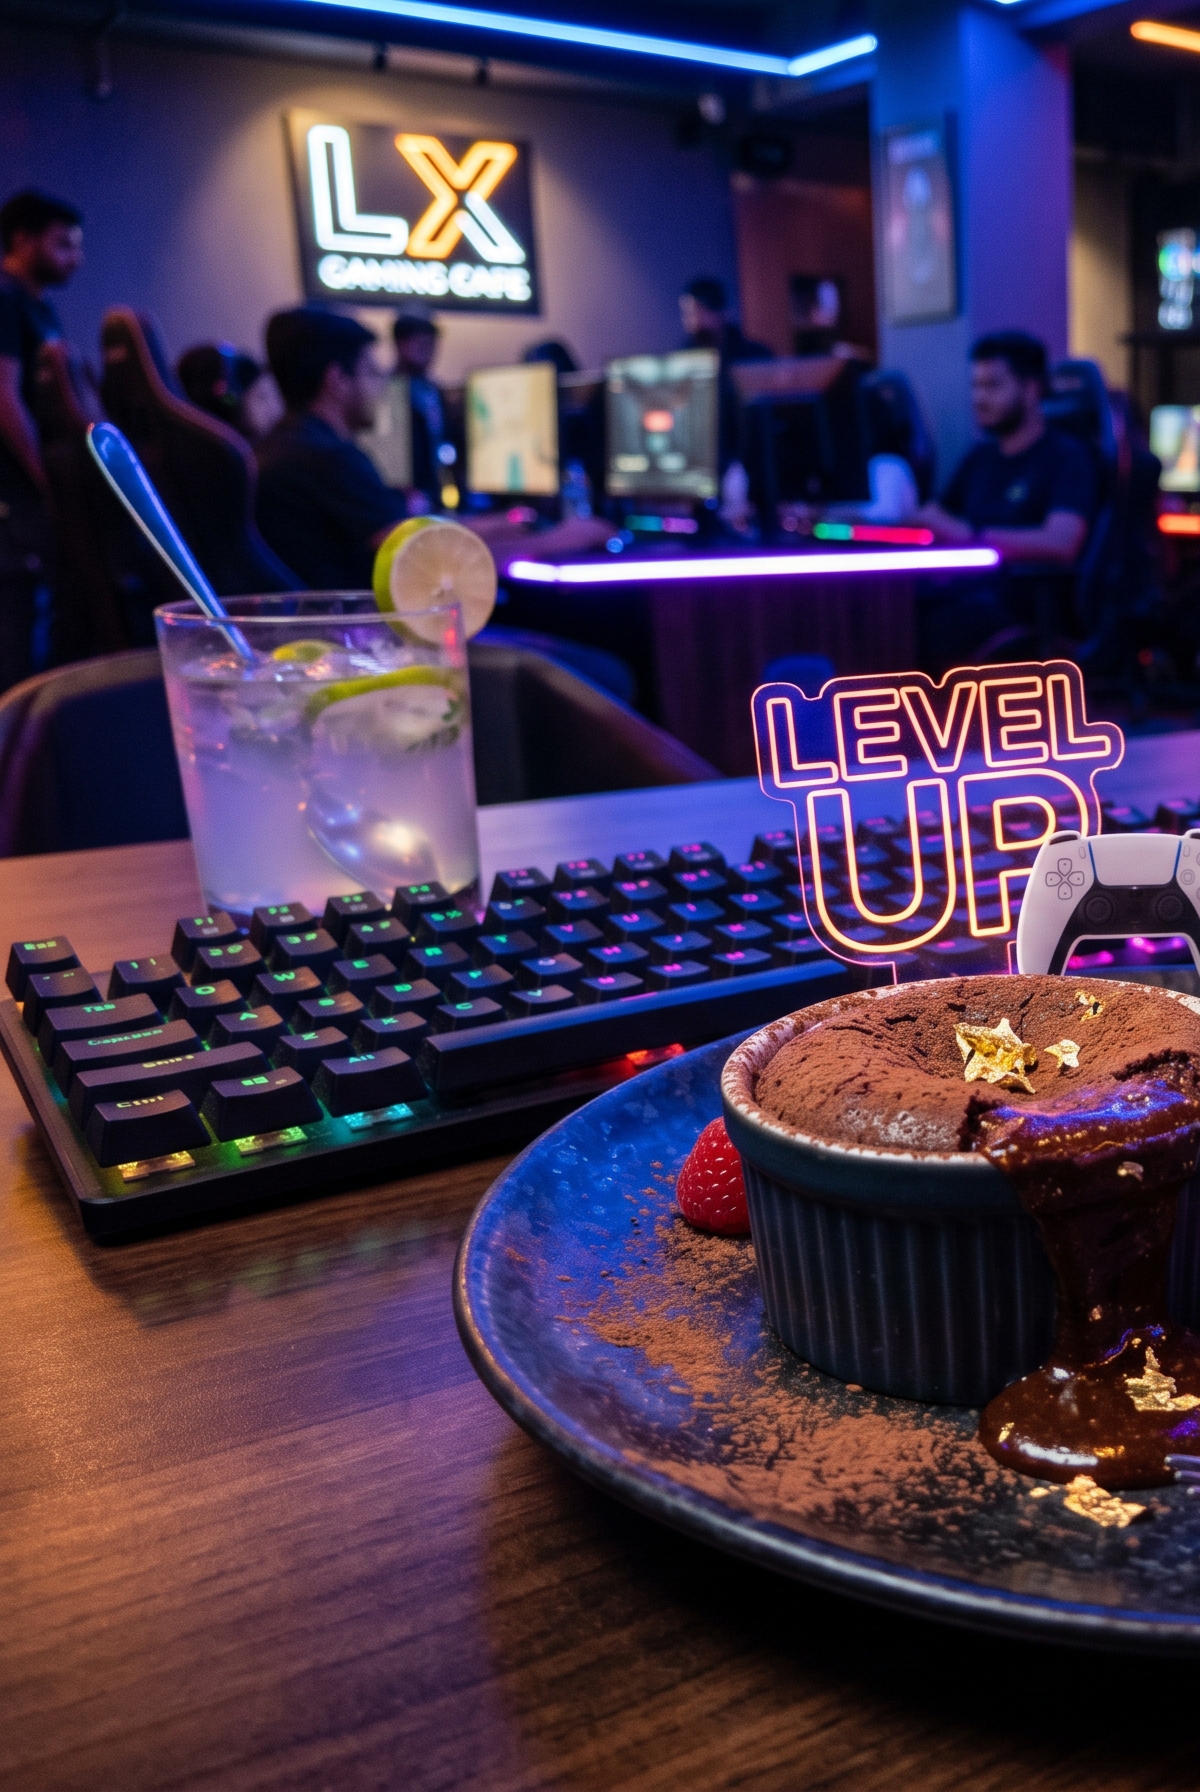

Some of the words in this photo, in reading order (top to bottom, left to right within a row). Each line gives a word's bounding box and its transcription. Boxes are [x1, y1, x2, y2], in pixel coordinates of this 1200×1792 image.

[308, 124, 526, 264] LX
[318, 254, 449, 296] GAMING
[766, 673, 1112, 789] LEVEL
[807, 768, 1088, 953] UP
